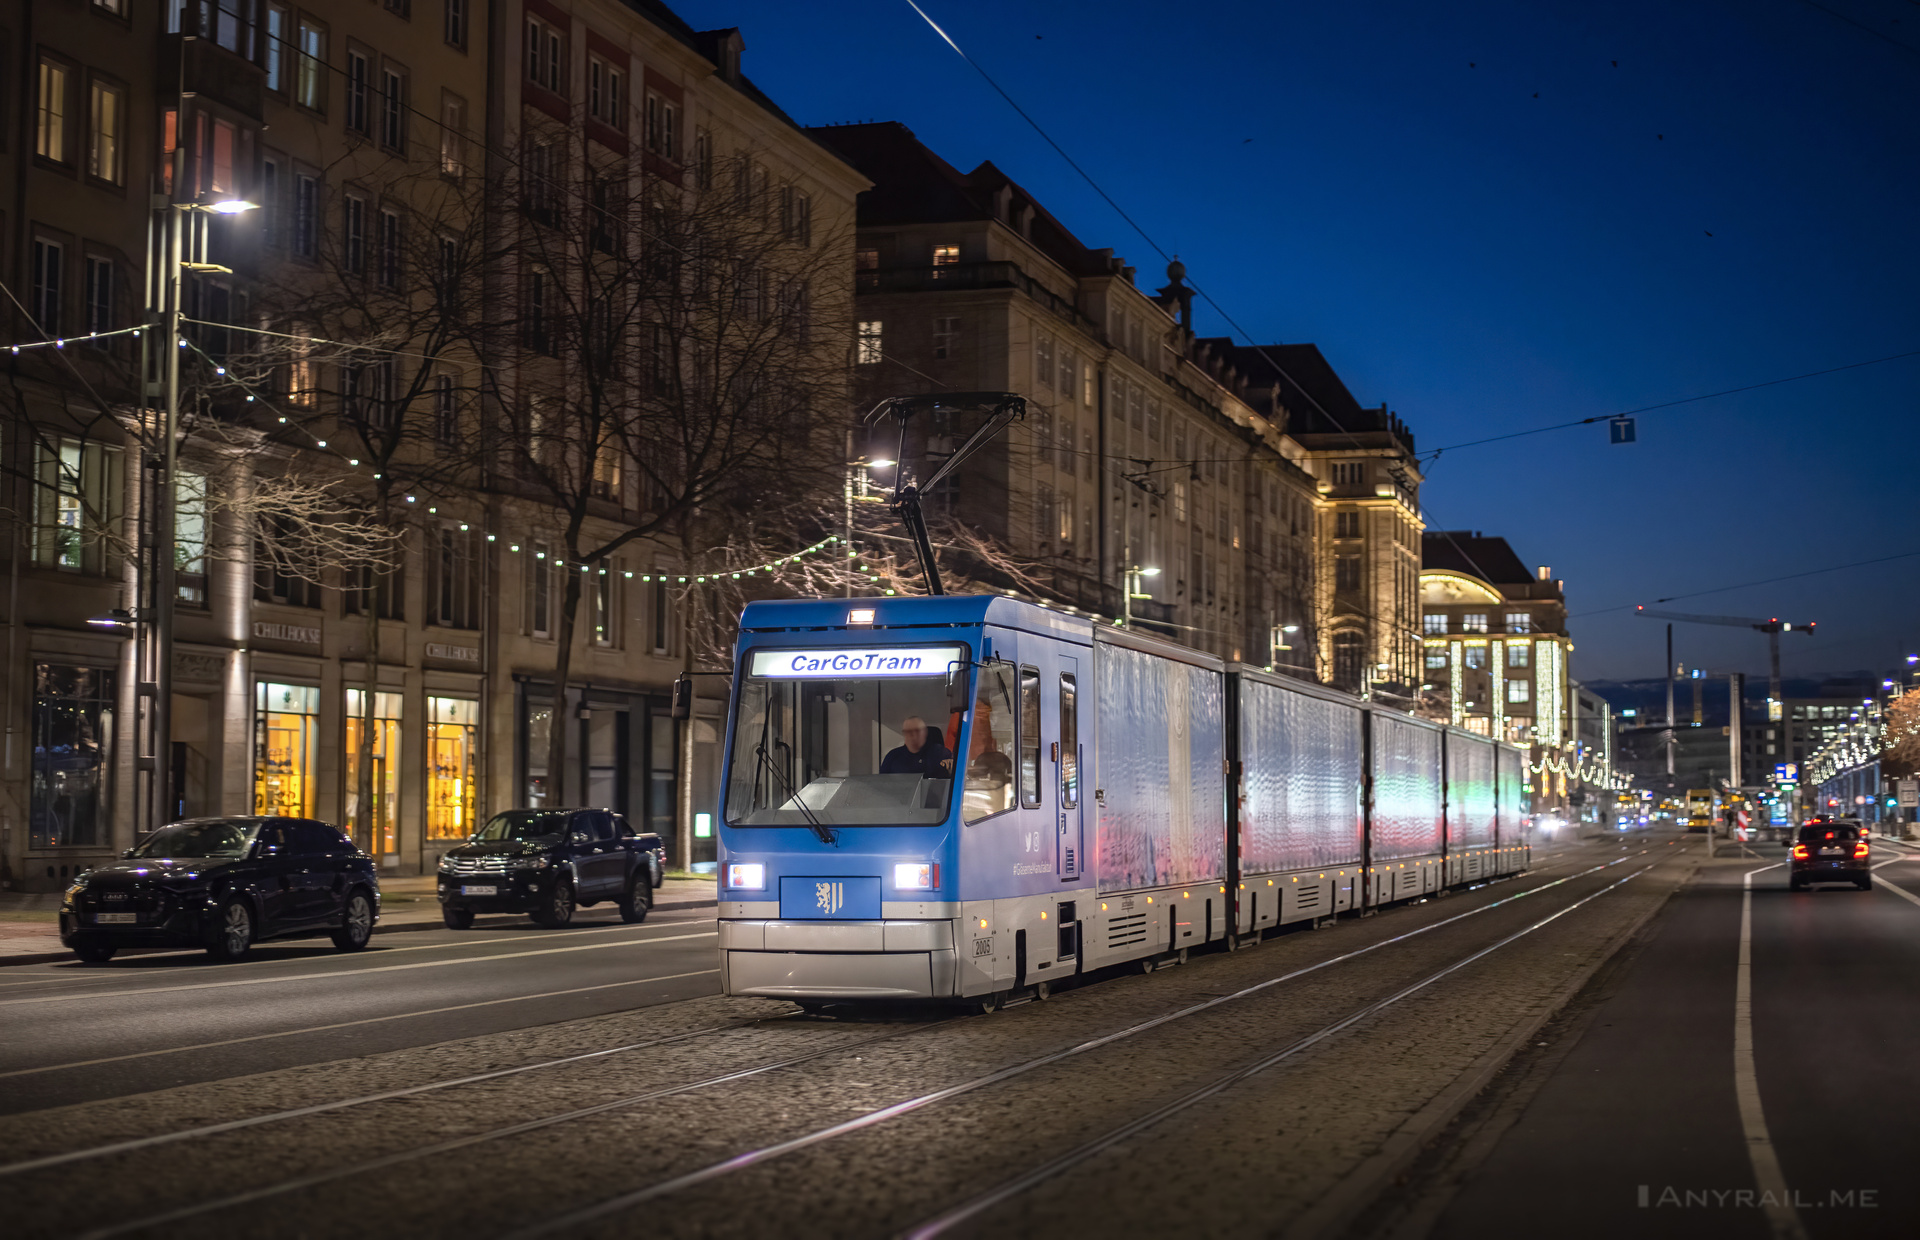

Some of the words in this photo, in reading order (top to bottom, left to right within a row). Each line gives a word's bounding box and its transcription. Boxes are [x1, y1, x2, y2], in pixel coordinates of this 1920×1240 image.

[1615, 421, 1631, 440] T
[791, 654, 922, 671] CarGoTram
[976, 939, 990, 955] 2005
